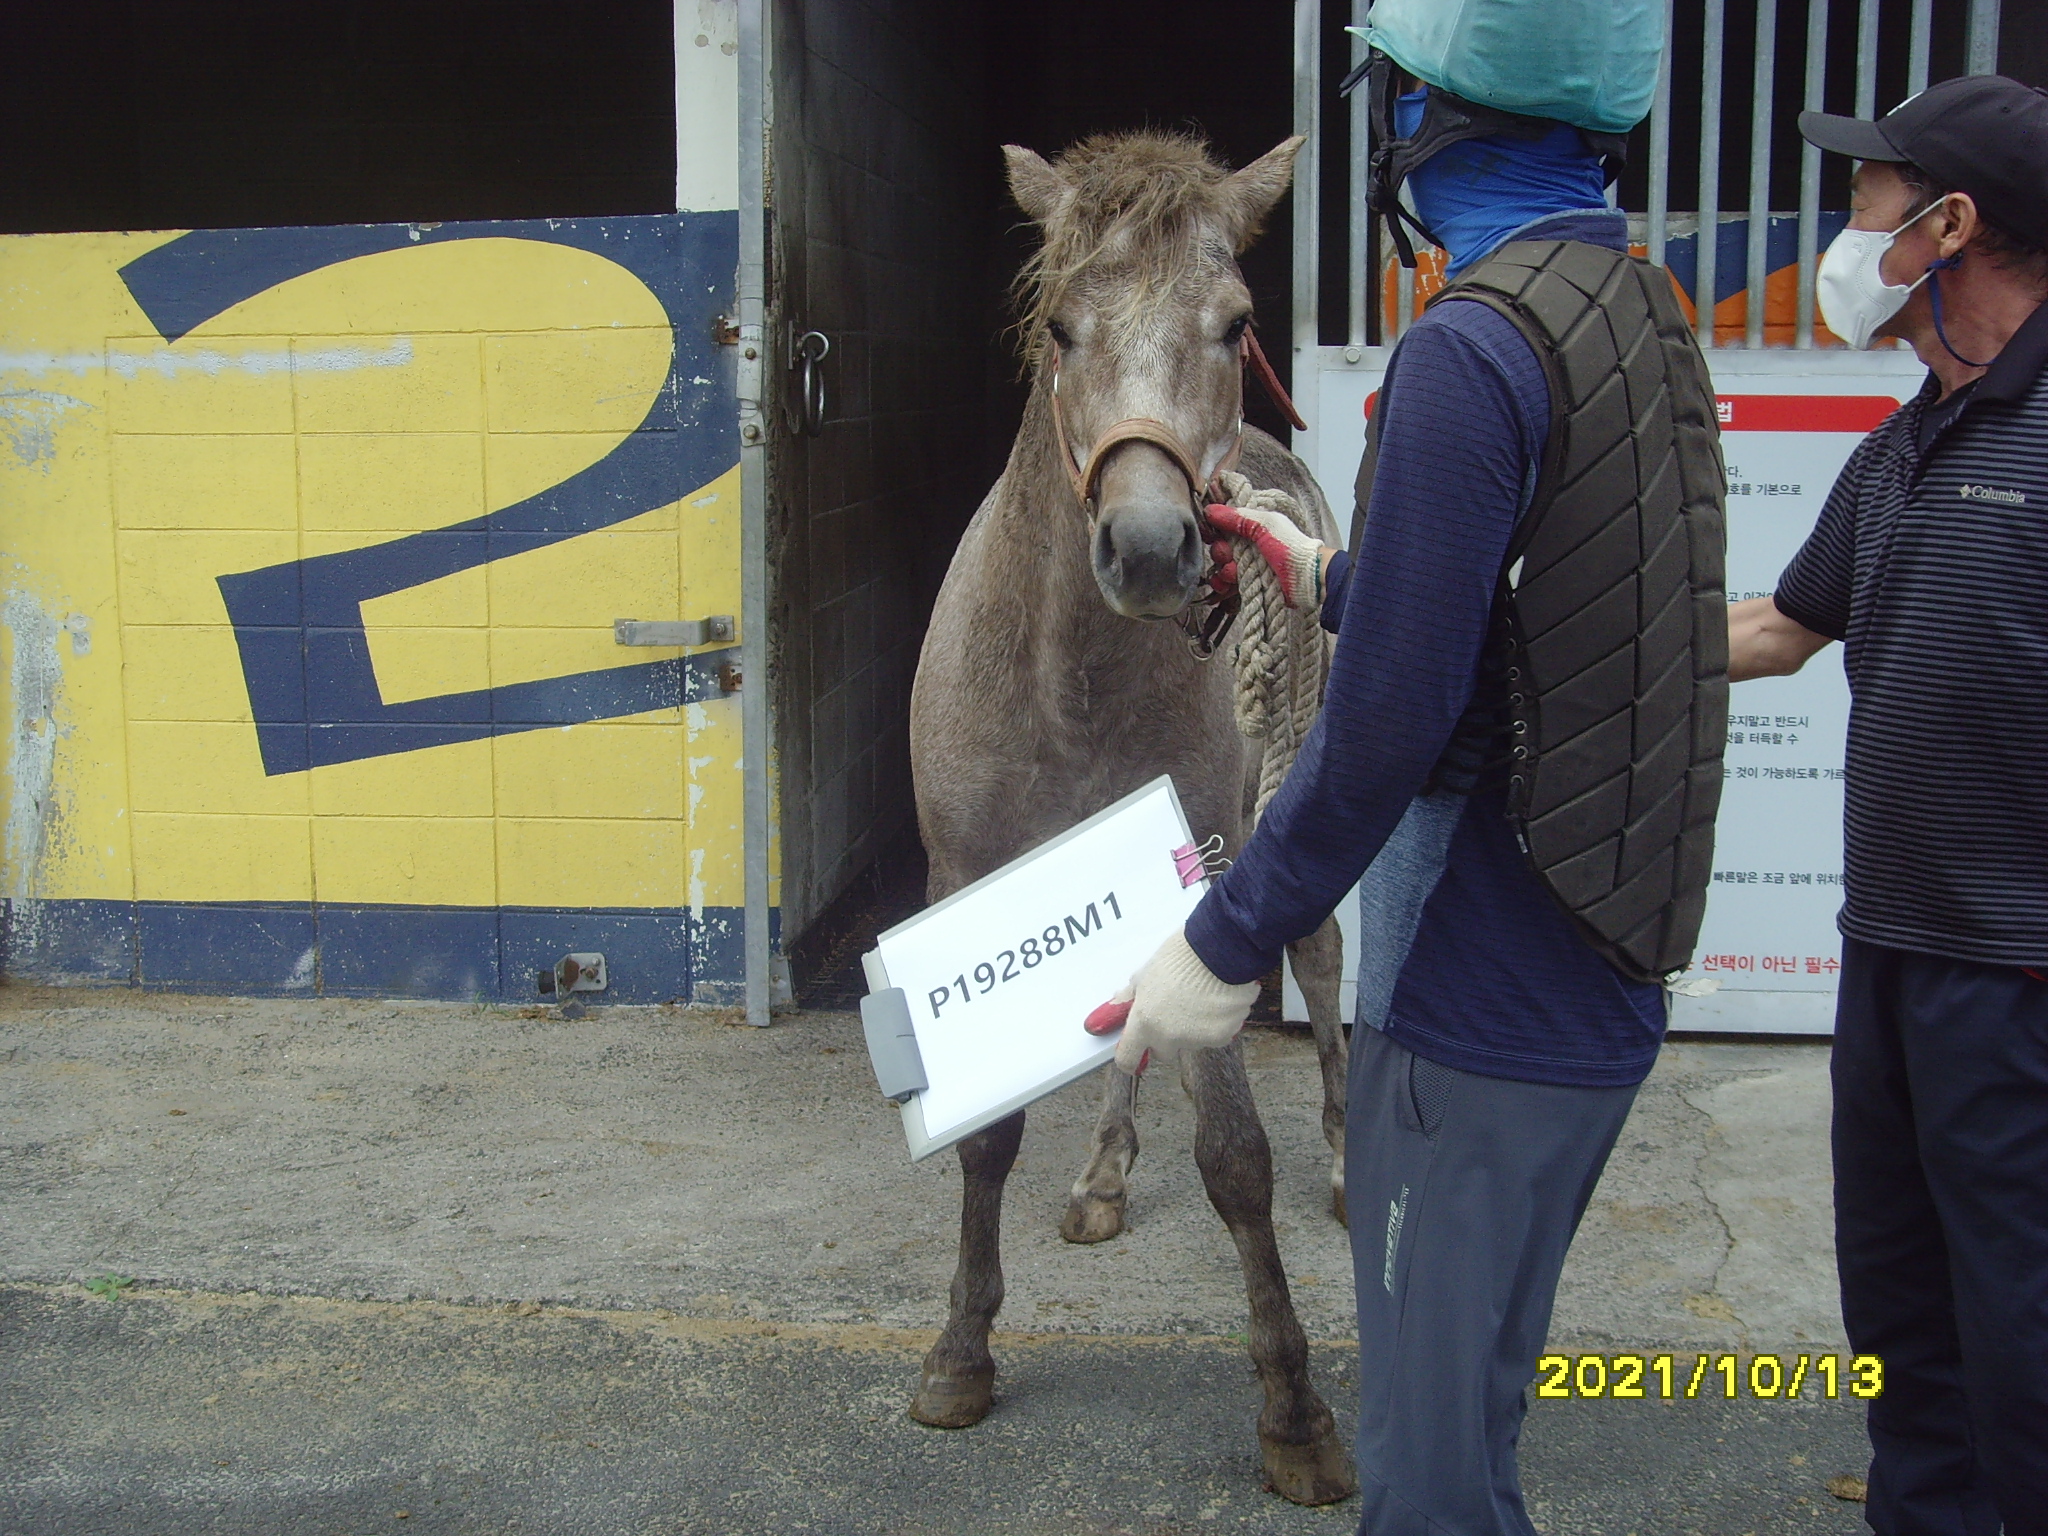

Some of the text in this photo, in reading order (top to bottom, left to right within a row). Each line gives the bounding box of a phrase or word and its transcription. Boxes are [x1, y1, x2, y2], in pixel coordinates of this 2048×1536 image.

[1725, 465, 1743, 478] 다.
[1756, 483, 1802, 496] 기본으로
[1972, 485, 2026, 503] Columbia
[1775, 715, 1809, 729] 반드시
[1749, 732, 1783, 745] 터득할
[1787, 733, 1799, 745] 수
[1736, 766, 1758, 779] 것이
[1763, 766, 1819, 780] 가능하도록
[1713, 871, 1758, 884] 빠른말은
[1762, 872, 1785, 885] 조금
[1789, 873, 1812, 885] 앞에
[928, 891, 1123, 1019] P19288M1
[1702, 954, 1754, 973] 선택이
[1762, 956, 1796, 974] 아닌
[1804, 956, 1840, 975] 필수
